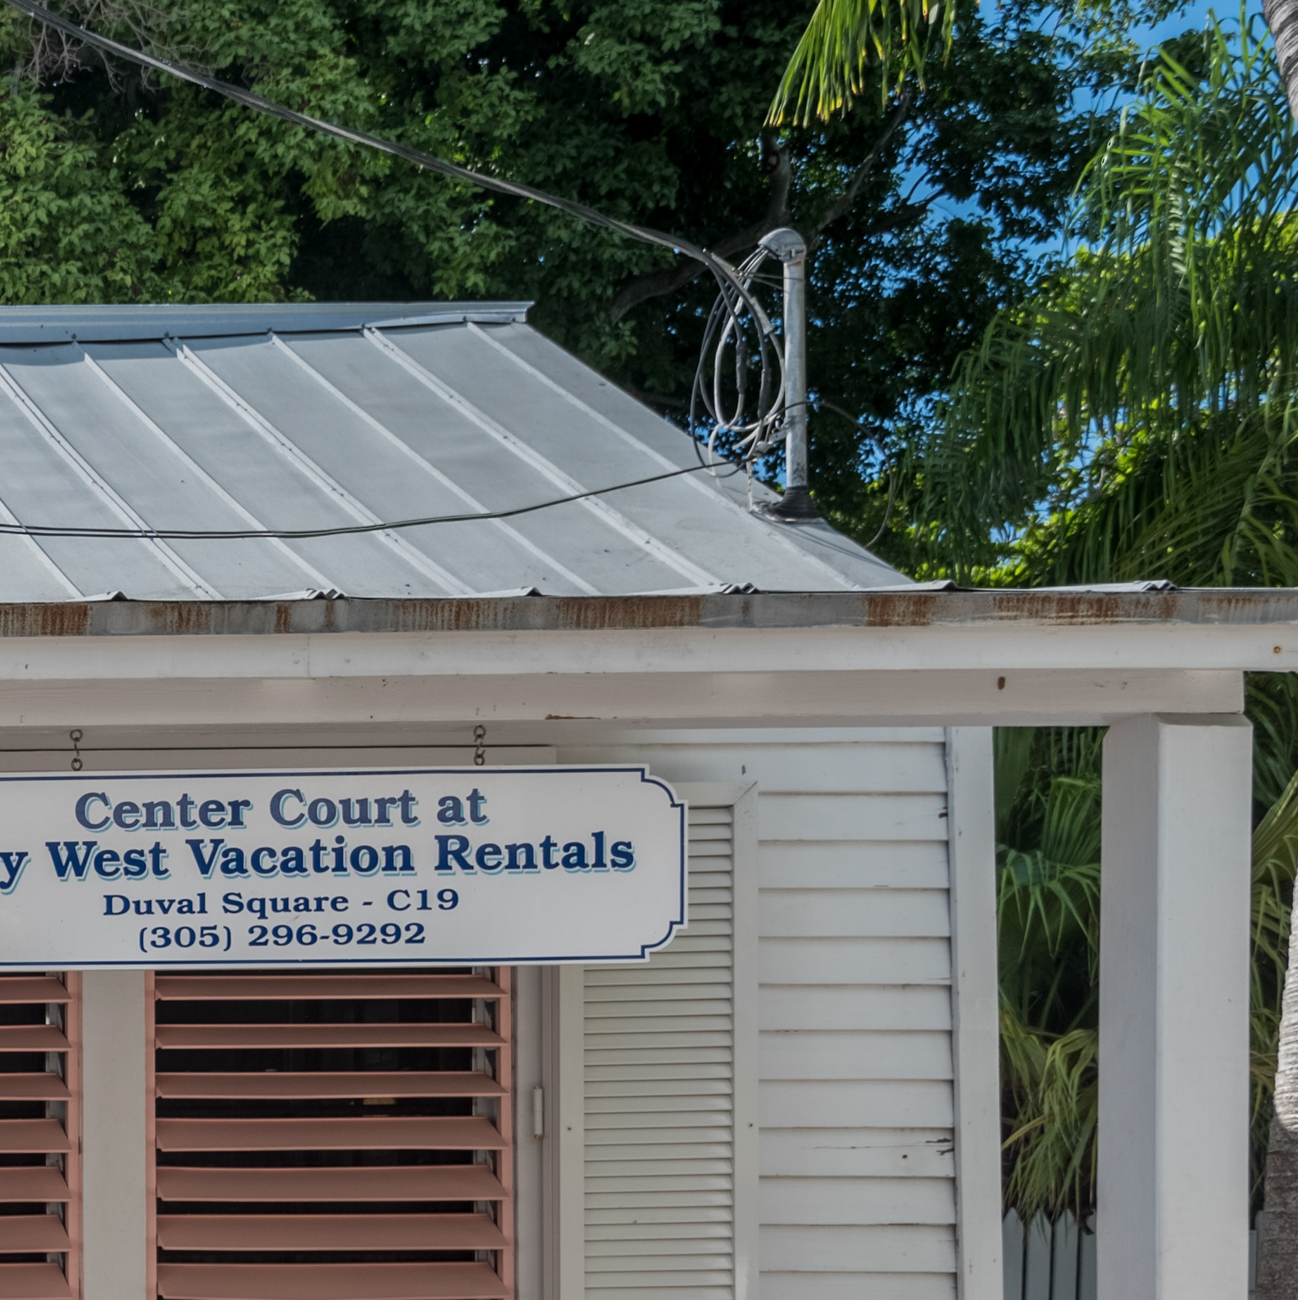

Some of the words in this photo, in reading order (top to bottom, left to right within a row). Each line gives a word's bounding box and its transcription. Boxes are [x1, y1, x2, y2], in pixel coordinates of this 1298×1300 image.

[74, 790, 253, 831] Center
[269, 788, 421, 830] Court
[436, 787, 490, 826] at
[45, 840, 172, 882] West
[184, 834, 418, 879] Vacation
[433, 830, 637, 876] Rentals
[102, 891, 209, 917] Duval
[221, 890, 350, 920] Square
[386, 888, 460, 912] C19
[138, 924, 233, 955] (305)
[247, 921, 427, 948] 296-9292
